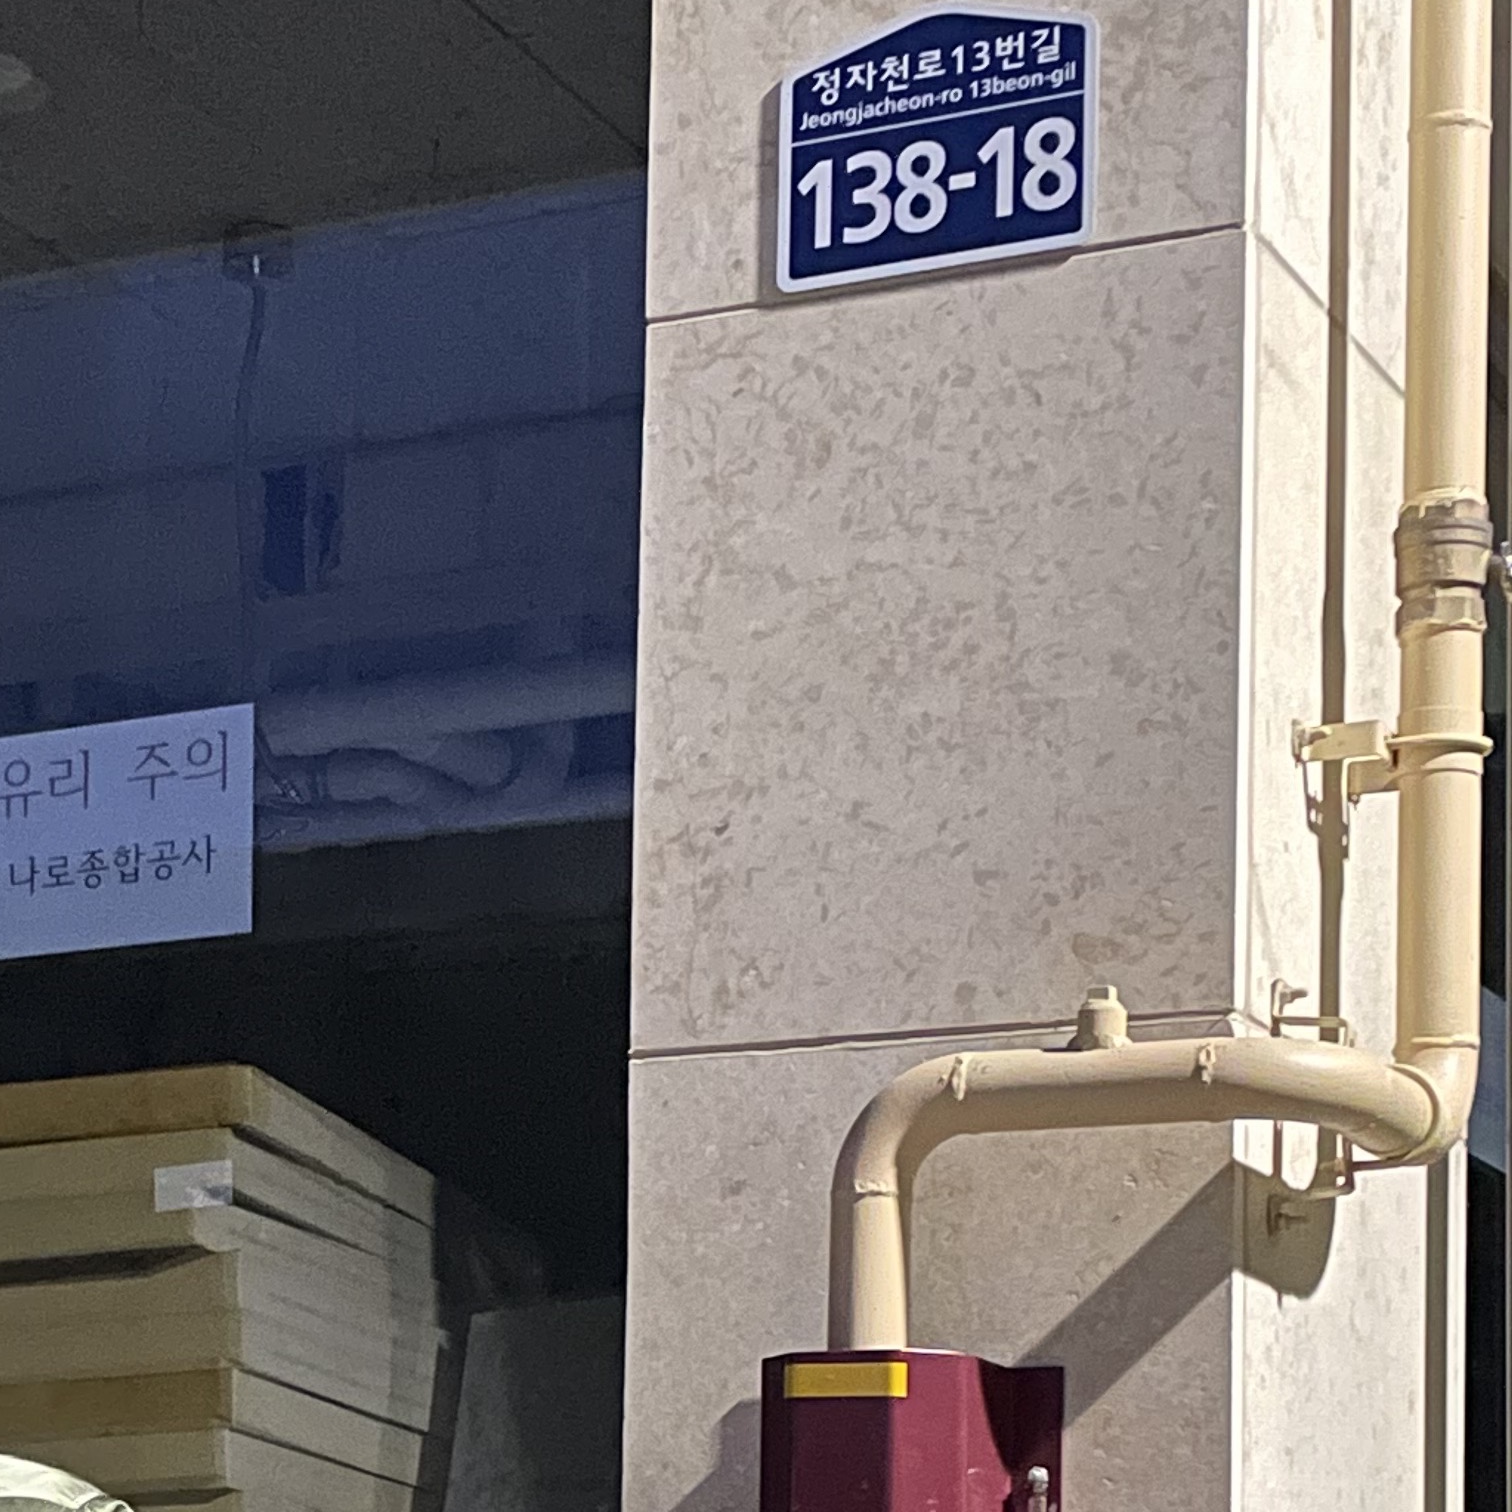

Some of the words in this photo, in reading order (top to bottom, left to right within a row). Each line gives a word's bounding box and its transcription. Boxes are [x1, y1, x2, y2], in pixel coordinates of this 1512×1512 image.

[800, 86, 963, 131] Jeongjacheon-ro
[969, 62, 1077, 100] 13beon-gil
[810, 24, 1063, 106] 정자천로13번길
[797, 116, 1078, 249] 138-18
[126, 729, 228, 800] 주의
[8, 834, 217, 896] 나로종합공사
